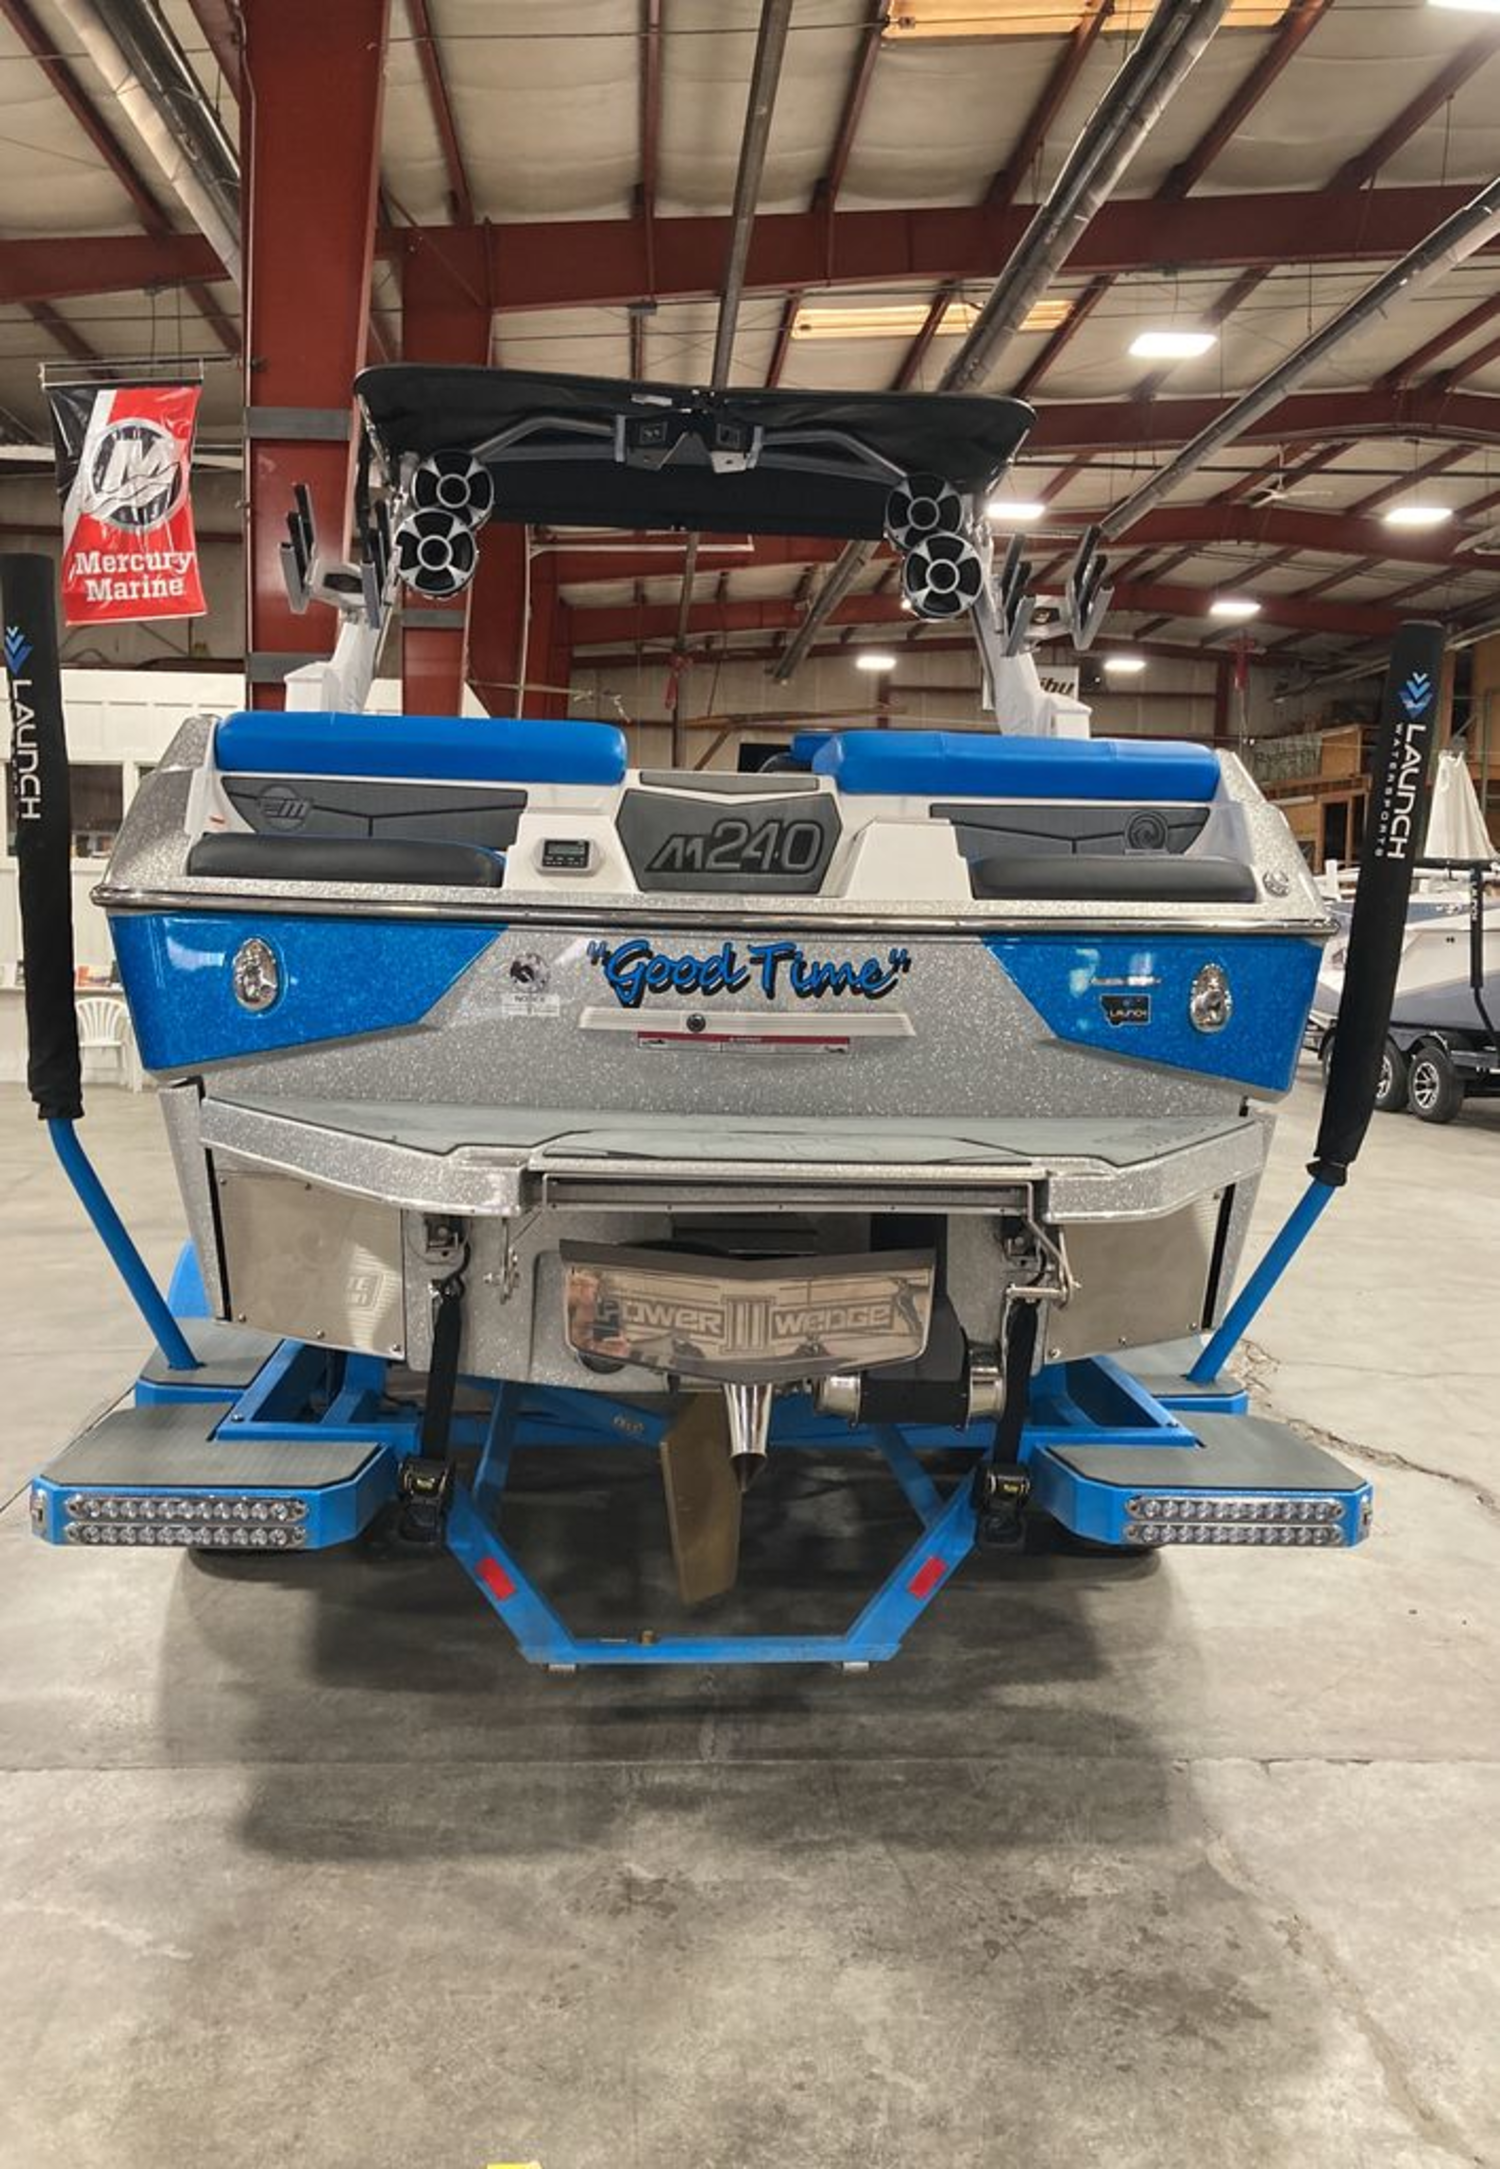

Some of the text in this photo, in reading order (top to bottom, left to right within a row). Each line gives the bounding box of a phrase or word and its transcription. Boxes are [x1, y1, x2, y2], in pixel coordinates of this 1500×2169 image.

[75, 551, 195, 575] Mercury
[84, 575, 186, 602] Marine
[1040, 677, 1075, 695] ibu
[587, 939, 912, 1008] "Good Time"
